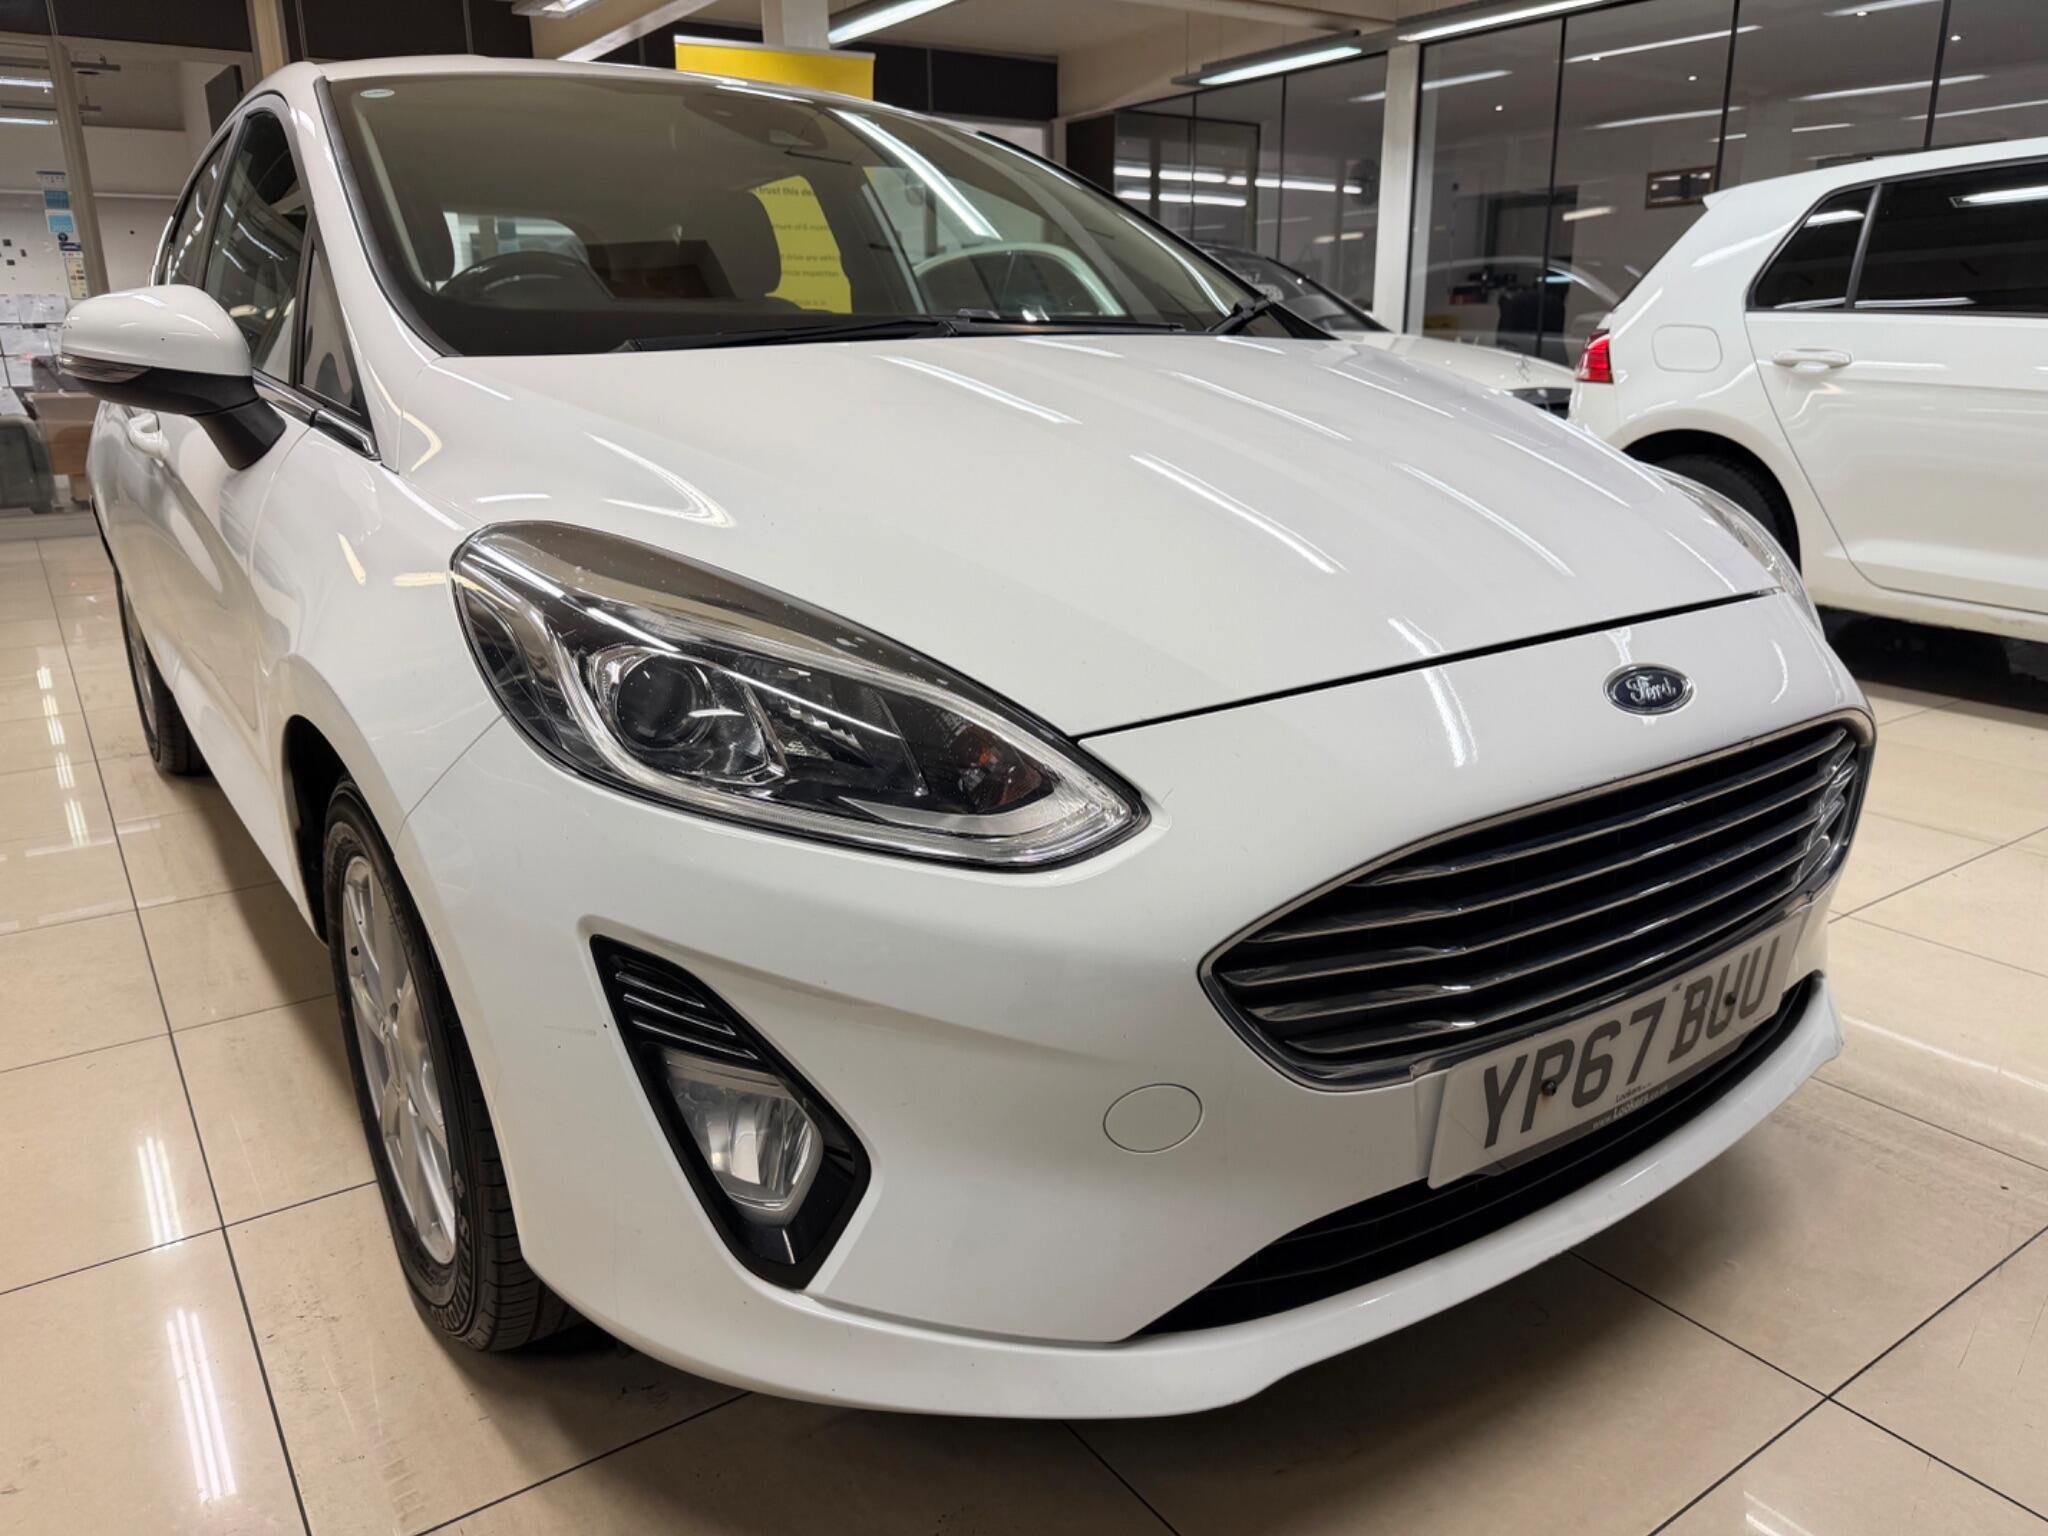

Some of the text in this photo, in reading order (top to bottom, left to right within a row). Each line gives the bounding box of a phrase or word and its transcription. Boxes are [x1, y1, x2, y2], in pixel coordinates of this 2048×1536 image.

[1625, 675, 1677, 704] Ford
[1483, 936, 1780, 1149] YP67 BUU
